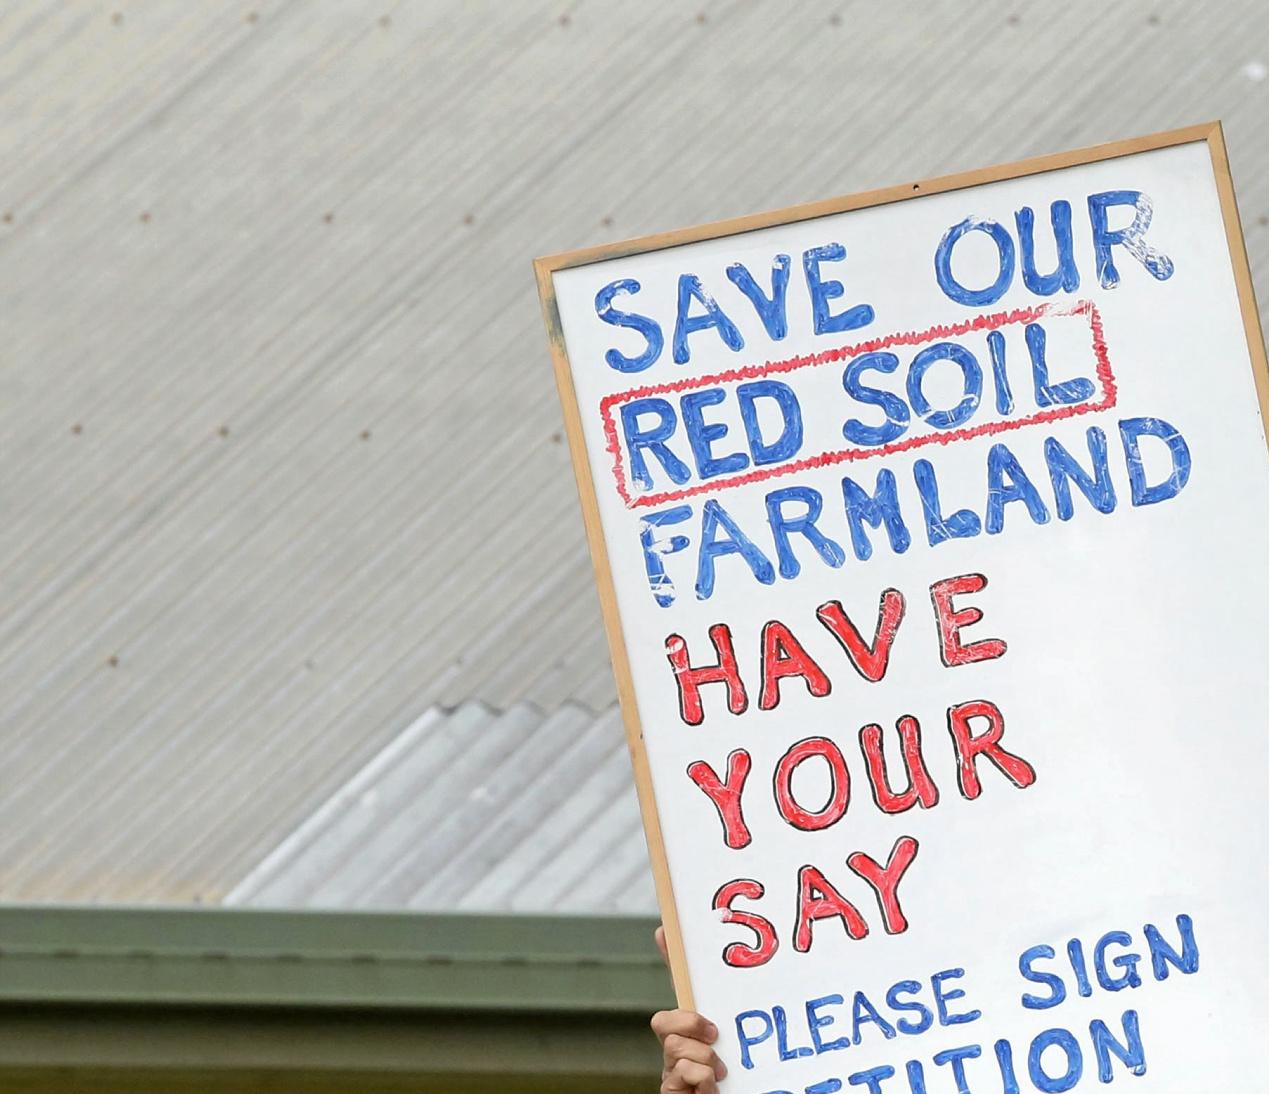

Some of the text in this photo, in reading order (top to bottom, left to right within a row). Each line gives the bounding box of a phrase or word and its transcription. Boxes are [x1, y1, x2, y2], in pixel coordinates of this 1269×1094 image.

[594, 189, 1176, 374] SAVE OUR
[619, 323, 1096, 492] RED SOIL
[639, 415, 1193, 608] FARMLAND
[665, 573, 1008, 727] HAVE
[686, 699, 1037, 850] YOUR
[711, 835, 920, 968] SAY
[735, 913, 1201, 1070] PLEASE SIGN
